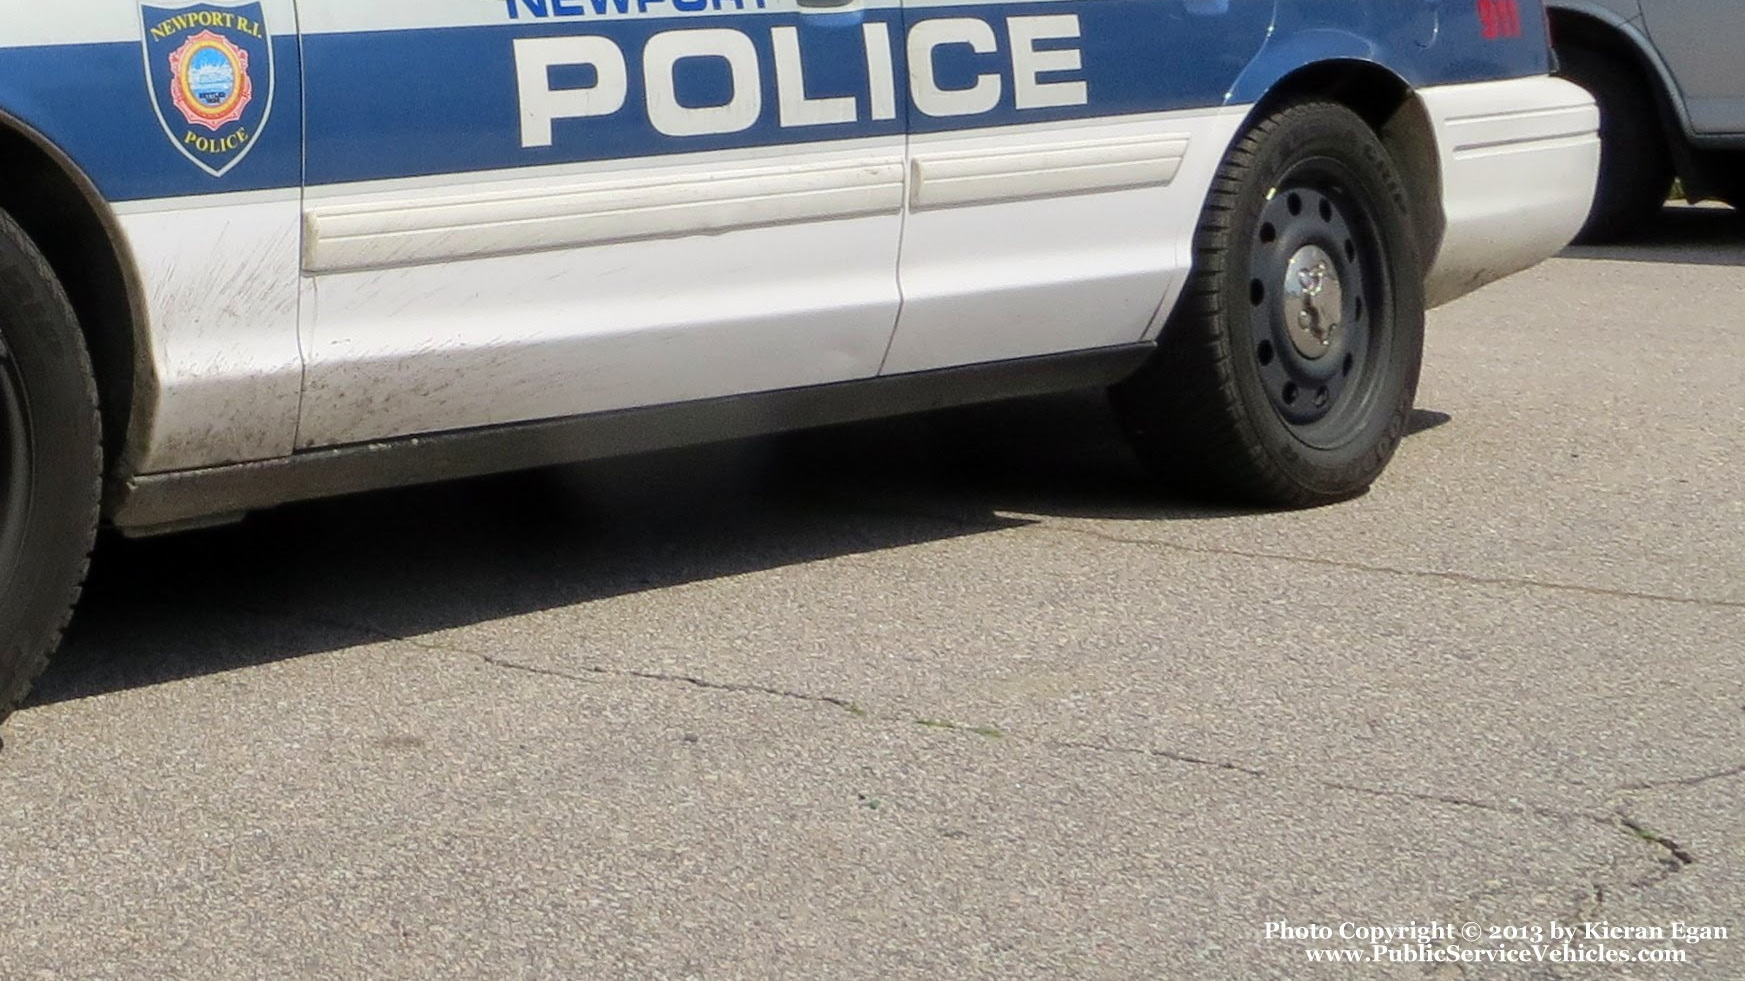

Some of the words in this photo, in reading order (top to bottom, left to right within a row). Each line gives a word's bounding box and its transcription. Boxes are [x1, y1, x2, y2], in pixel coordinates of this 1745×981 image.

[149, 10, 235, 42] NEWPORT
[237, 12, 263, 40] R.I.
[512, 13, 1088, 149] POLICE
[183, 126, 250, 154] POLICE
